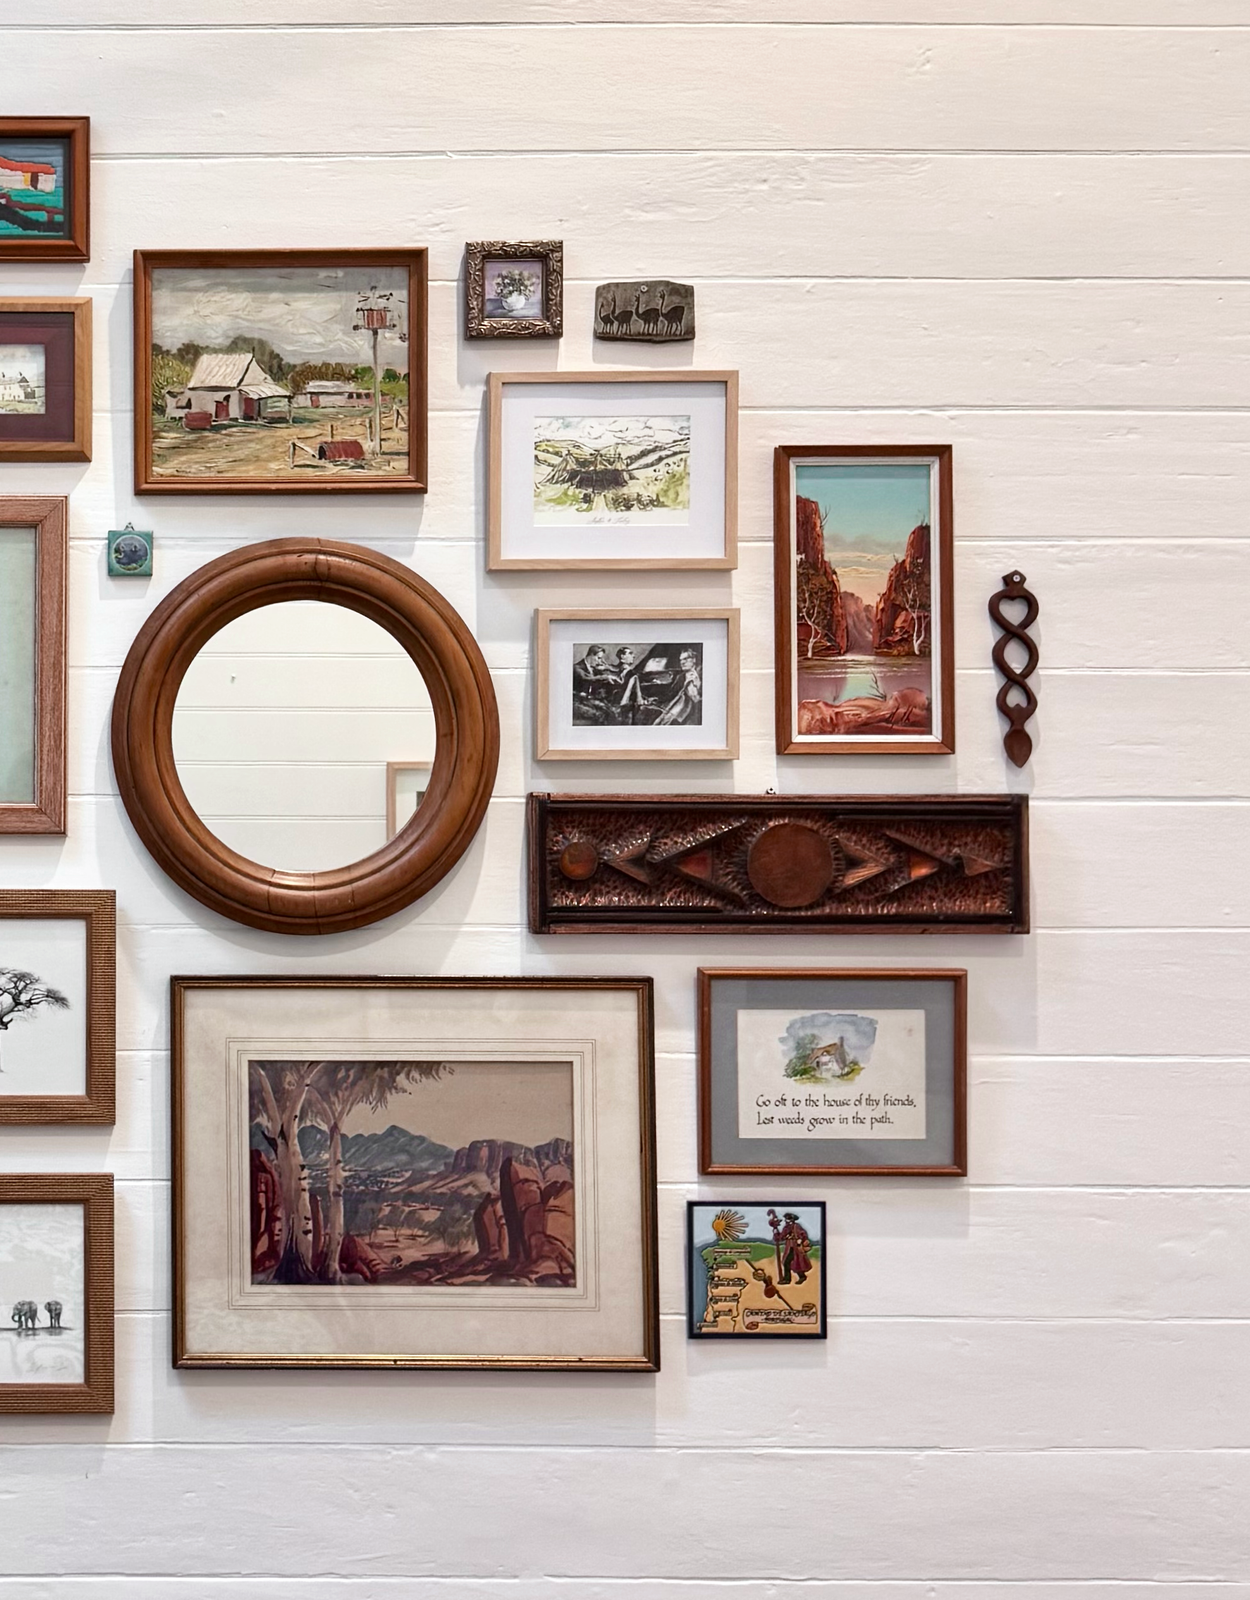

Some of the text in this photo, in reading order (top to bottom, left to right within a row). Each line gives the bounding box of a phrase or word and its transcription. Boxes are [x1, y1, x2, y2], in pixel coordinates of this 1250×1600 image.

[755, 1094, 771, 1108] Go
[774, 1093, 787, 1107] oft
[791, 1098, 802, 1107] to
[804, 1093, 820, 1107] the
[823, 1093, 851, 1107] house
[853, 1093, 864, 1107] of
[865, 1093, 880, 1111] thy
[756, 1111, 894, 1132] Lest weeds grow in the path.
